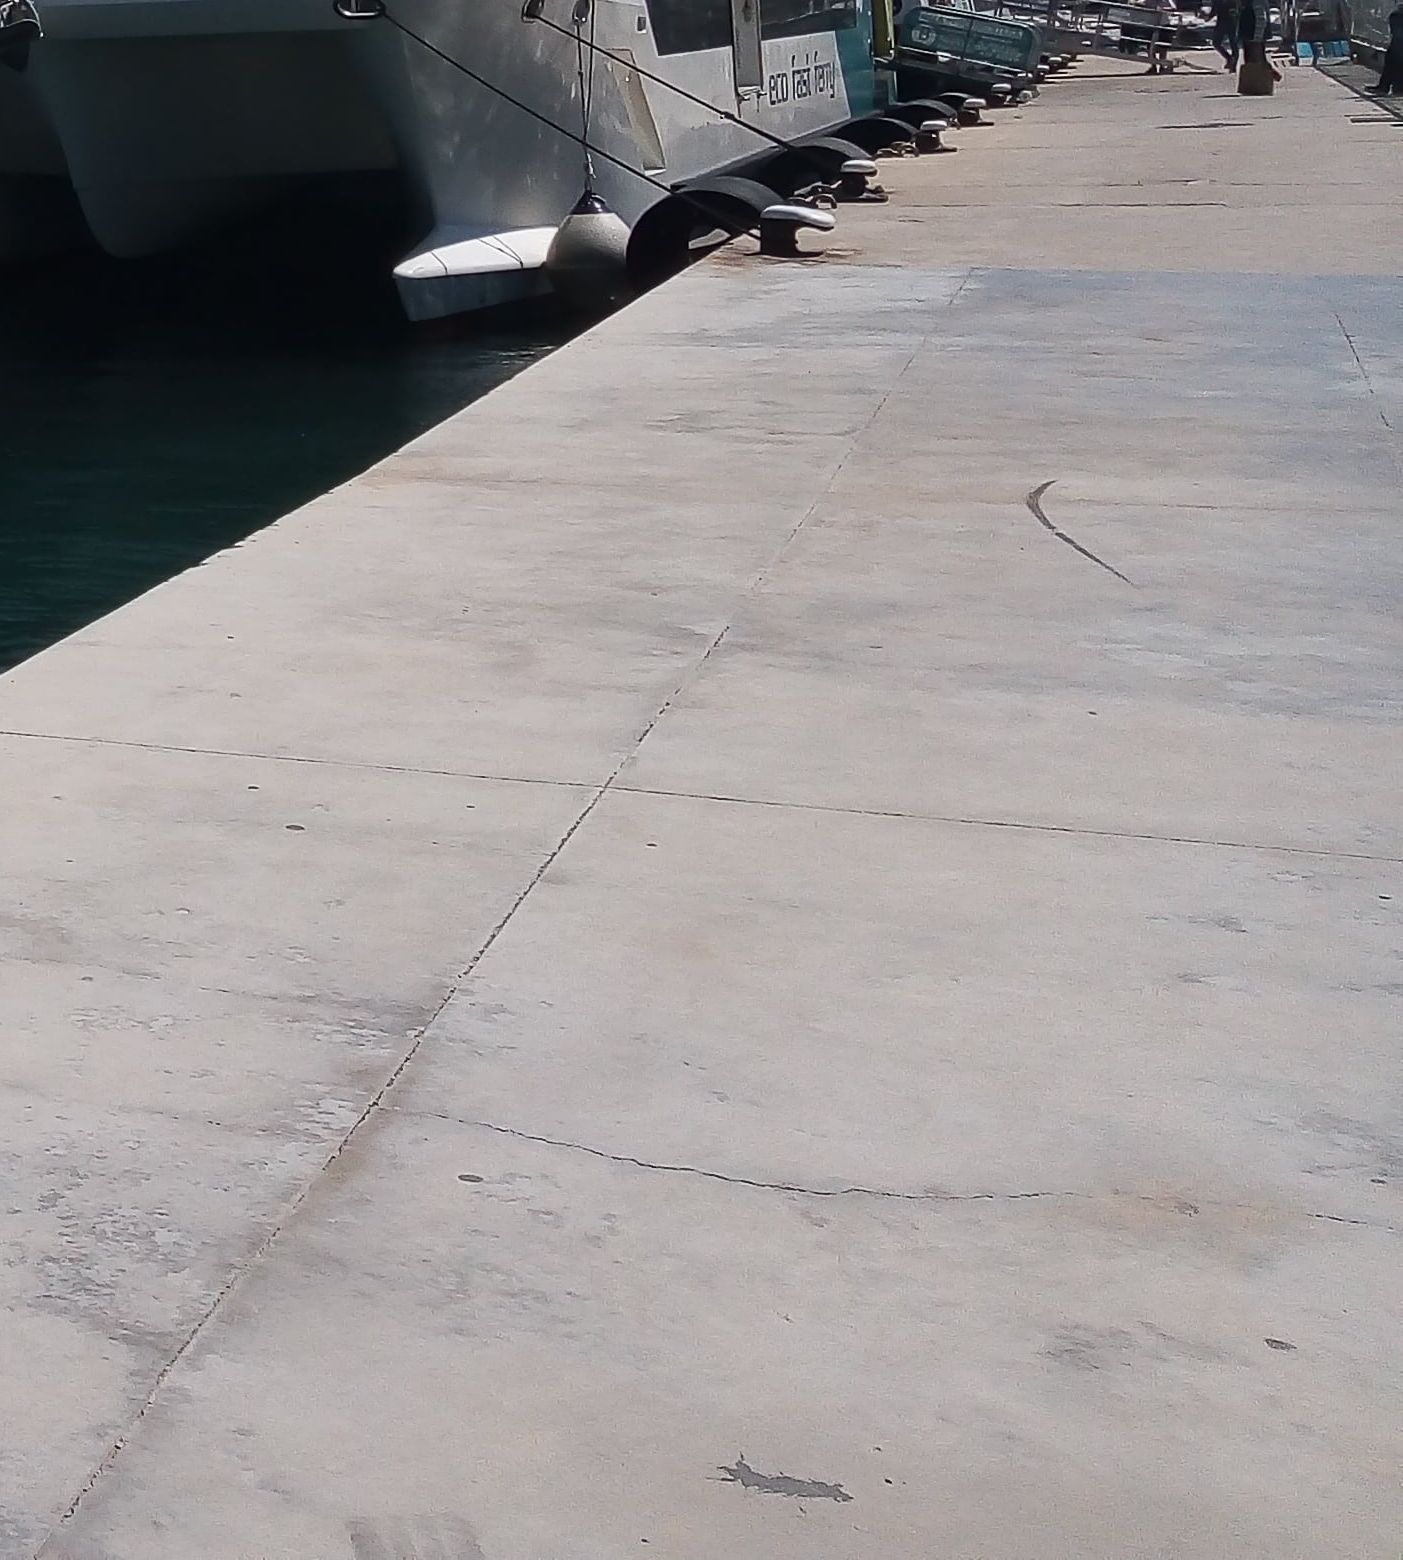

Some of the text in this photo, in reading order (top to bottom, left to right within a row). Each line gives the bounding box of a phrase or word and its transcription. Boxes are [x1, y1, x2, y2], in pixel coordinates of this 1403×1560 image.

[769, 50, 835, 105] eco fast ferry
